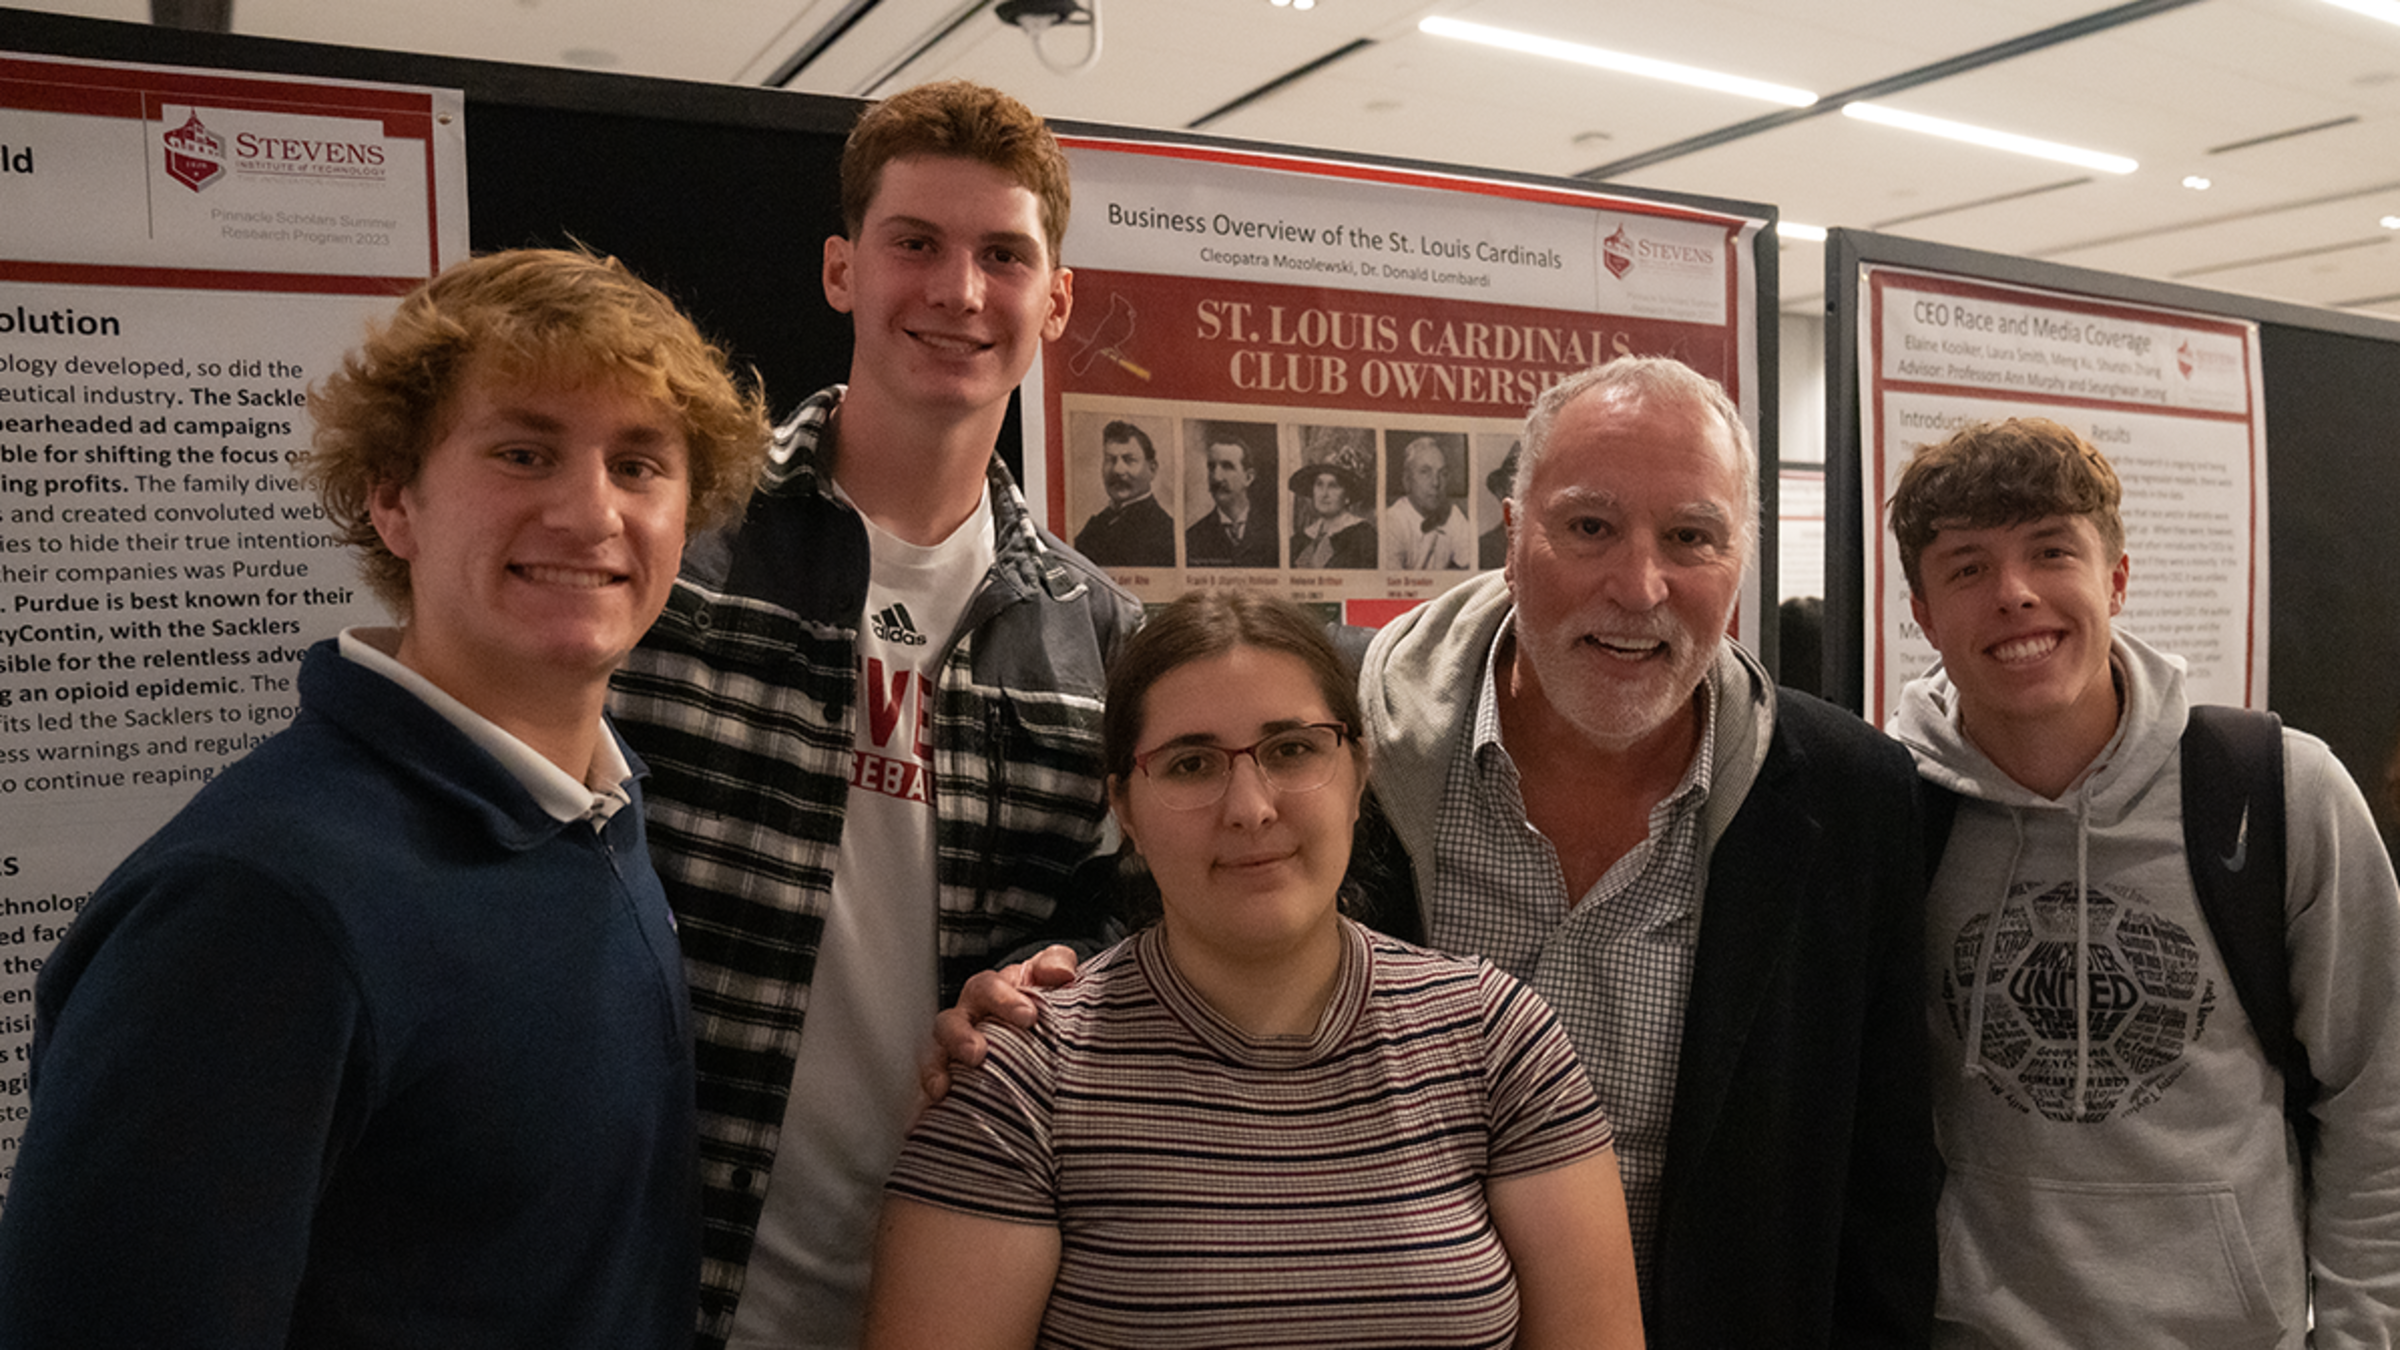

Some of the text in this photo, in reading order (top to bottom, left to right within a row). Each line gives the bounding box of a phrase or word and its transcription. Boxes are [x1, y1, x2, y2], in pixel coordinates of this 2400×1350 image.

[236, 132, 386, 166] STEVENS
[236, 160, 293, 171] INSTITUTE
[312, 165, 386, 176] TECHNOLOGY
[211, 208, 397, 229] Pinnacle Scholars Summer
[222, 226, 390, 246] Research Program 2023
[1108, 203, 1563, 270] Business Overview of the St. Louis Cardinals
[1639, 238, 1714, 264] STEVENS
[1200, 247, 1491, 287] Cleopatra Mozolewski, Dr. Donald Lombardi
[1197, 299, 1631, 368] ST. LOUIS CARDINALS
[1914, 300, 2151, 356] CEO Race and Media Coverage
[1905, 334, 1938, 353] Elaine
[1986, 345, 2014, 360] Laura
[65, 356, 191, 379] developed,
[198, 363, 221, 377] so
[229, 360, 261, 377] did
[268, 361, 303, 378] the
[1230, 349, 1348, 394] CLUB
[1898, 359, 1945, 378] Advisor:
[1948, 363, 2001, 383] Professors
[2004, 370, 2024, 384] Ann
[2028, 373, 2065, 393] Murphy
[84, 386, 183, 408] industry.
[190, 388, 231, 406] The
[139, 416, 166, 434] ad
[174, 418, 291, 438] campaigns
[2091, 424, 2131, 443] Results
[44, 444, 78, 463] for
[85, 445, 171, 468] shifting
[177, 446, 214, 463] the
[221, 446, 278, 463] focus
[45, 474, 128, 496] profits.
[135, 475, 176, 492] The
[183, 474, 249, 495] family
[11, 505, 54, 523] and
[62, 504, 146, 523] created
[154, 503, 274, 522] convoluted
[38, 537, 62, 552] to
[70, 534, 119, 552] hide
[126, 533, 179, 551] their
[185, 535, 230, 550] true
[56, 563, 177, 584] companies
[184, 565, 225, 579] was
[233, 560, 308, 577] Purdue
[15, 587, 353, 612] Purdue is best known for their
[110, 621, 161, 639] with
[168, 620, 205, 637] the
[212, 617, 300, 636] Sacklers
[872, 623, 928, 647] adidas
[57, 653, 91, 671] for
[98, 652, 135, 669] the
[144, 648, 251, 667] relentless
[20, 688, 48, 702] an
[55, 680, 129, 704] opioid
[136, 677, 244, 700] epidemic.
[251, 675, 289, 691] The
[38, 712, 72, 731] led
[80, 711, 117, 729] the
[125, 707, 213, 727] Sacklers
[220, 707, 241, 722] to
[37, 741, 140, 761] warnings
[147, 736, 187, 755] and
[24, 771, 124, 791] continue
[132, 761, 215, 786] reaping
[3, 956, 43, 975] the
